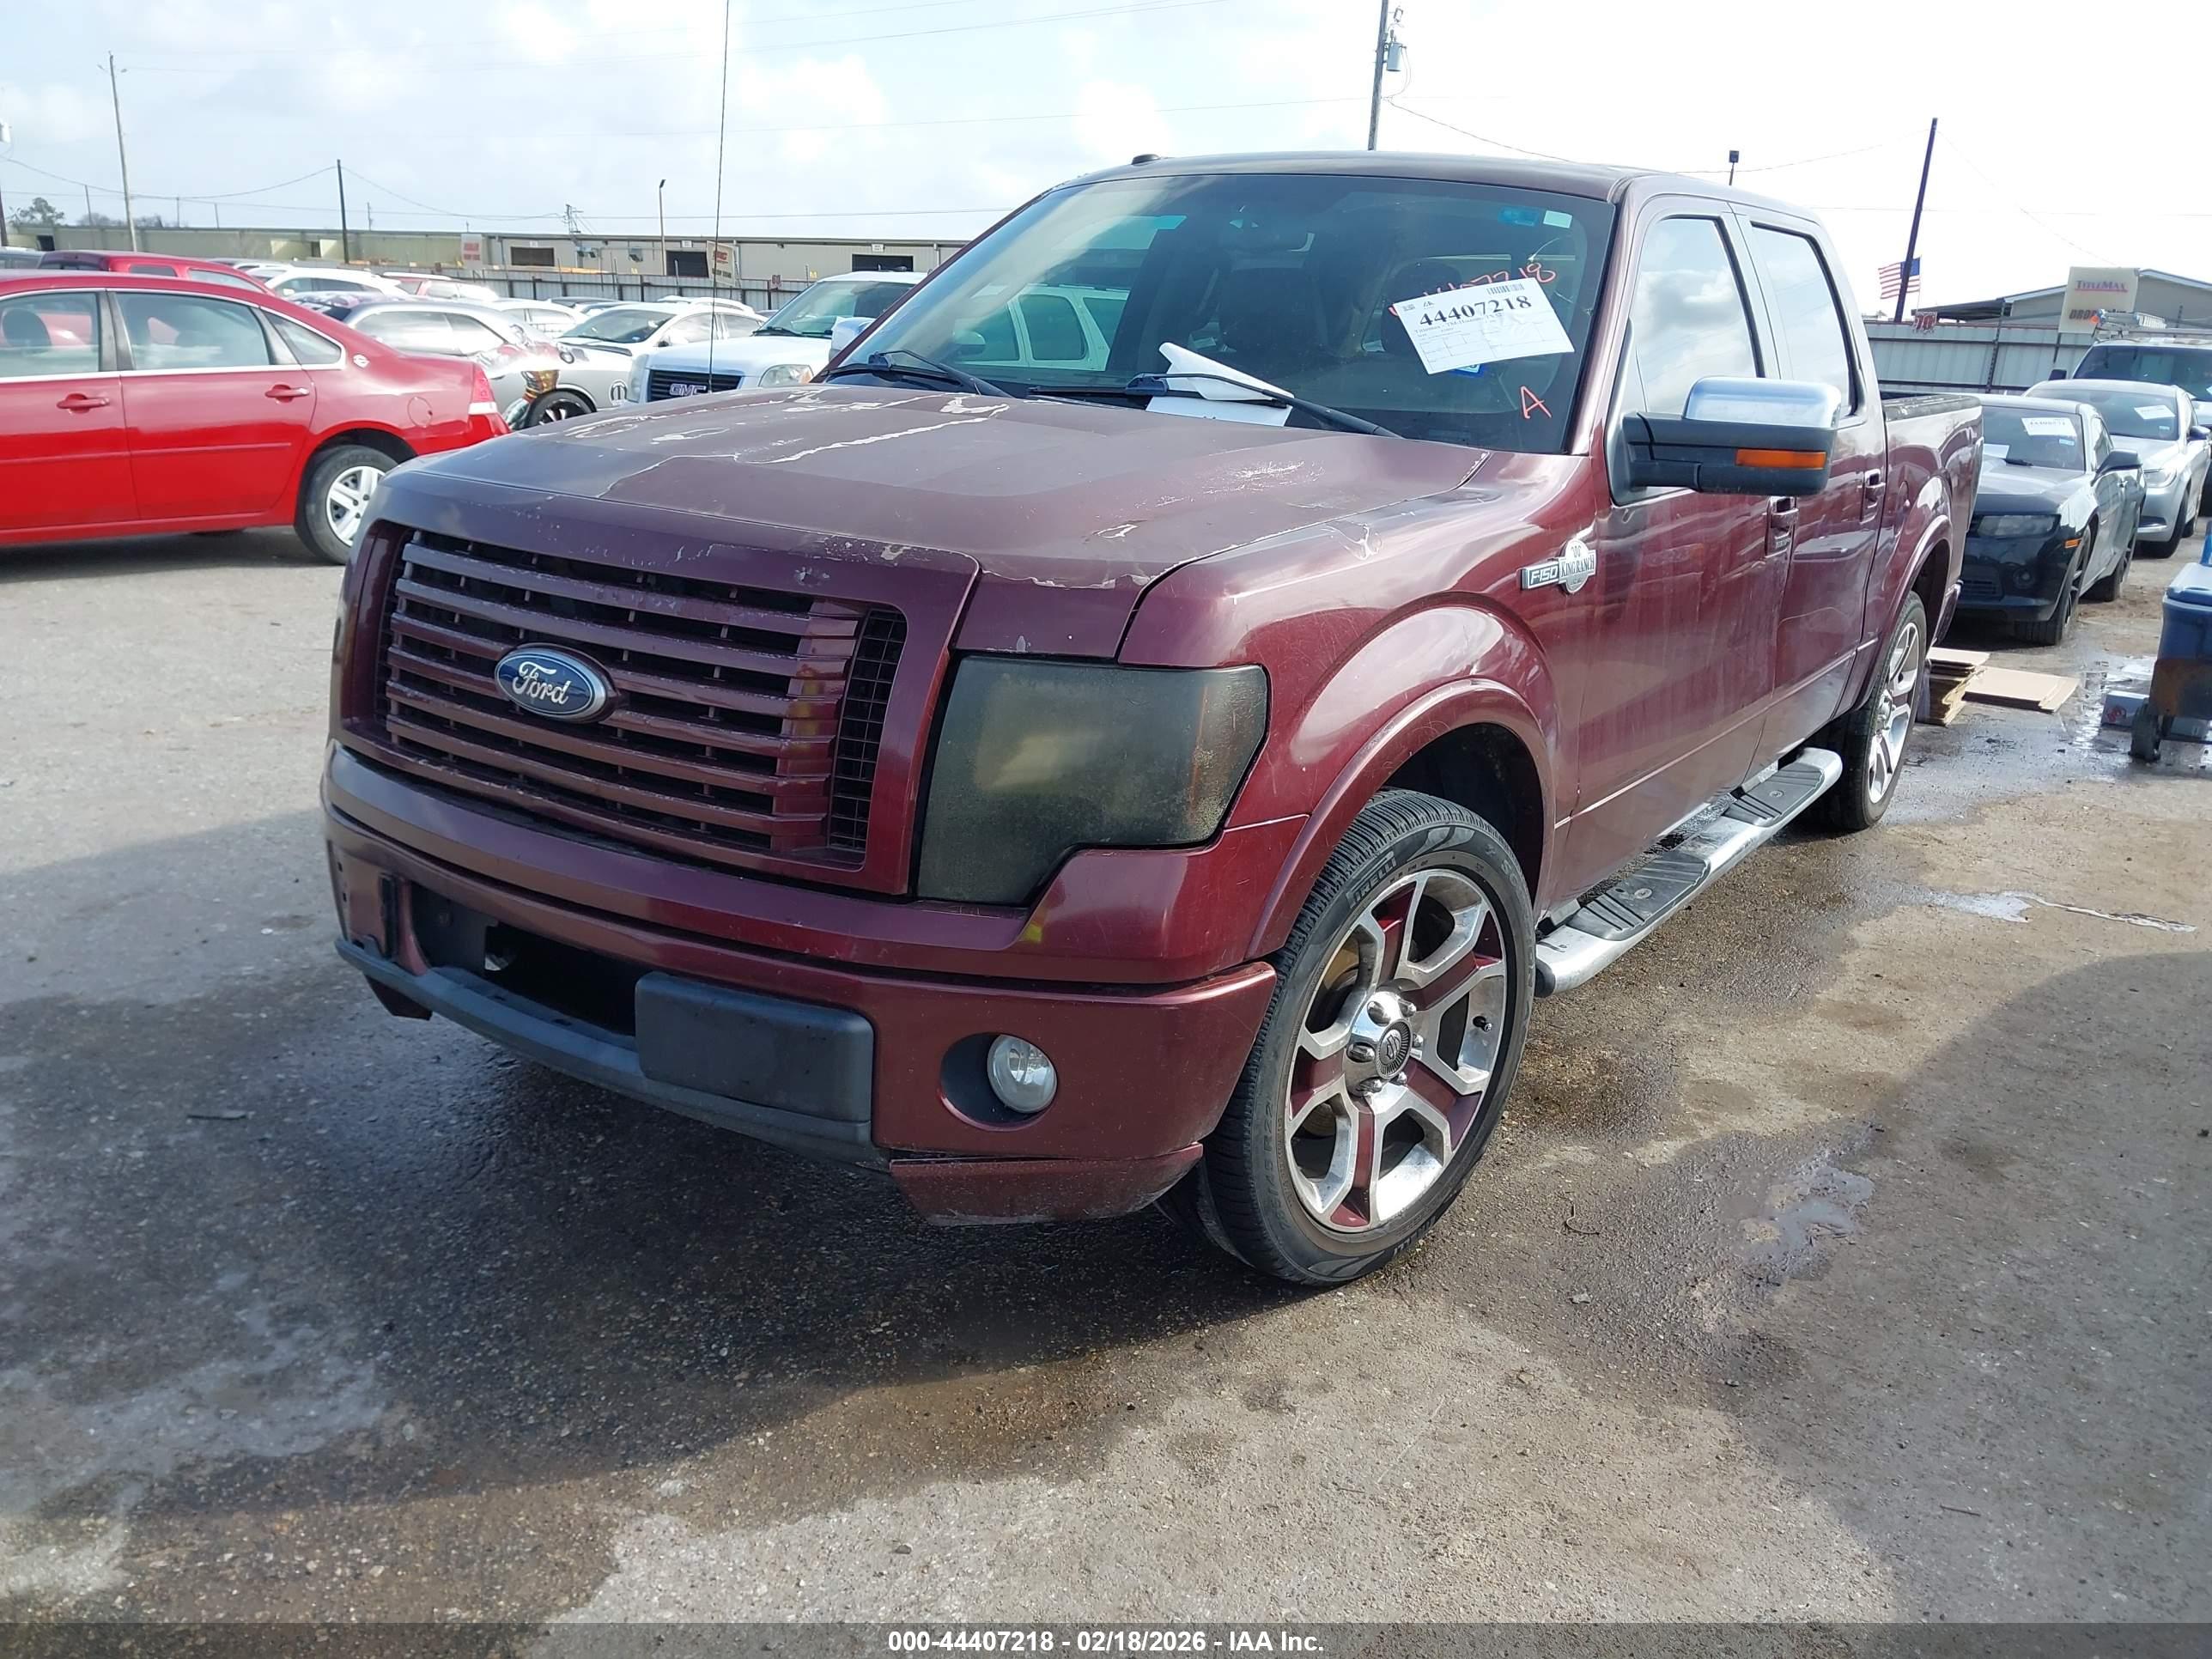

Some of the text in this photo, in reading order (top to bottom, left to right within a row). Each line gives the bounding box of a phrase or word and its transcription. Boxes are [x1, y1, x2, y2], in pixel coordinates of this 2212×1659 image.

[1419, 295, 1532, 326] 44407218
[670, 383, 707, 396] GMC
[1520, 386, 1553, 419] A
[1530, 565, 1559, 585] F-150
[1559, 554, 1595, 578] KING RANCH
[513, 661, 572, 704] Ford
[1346, 851, 1397, 908] PIRELLI
